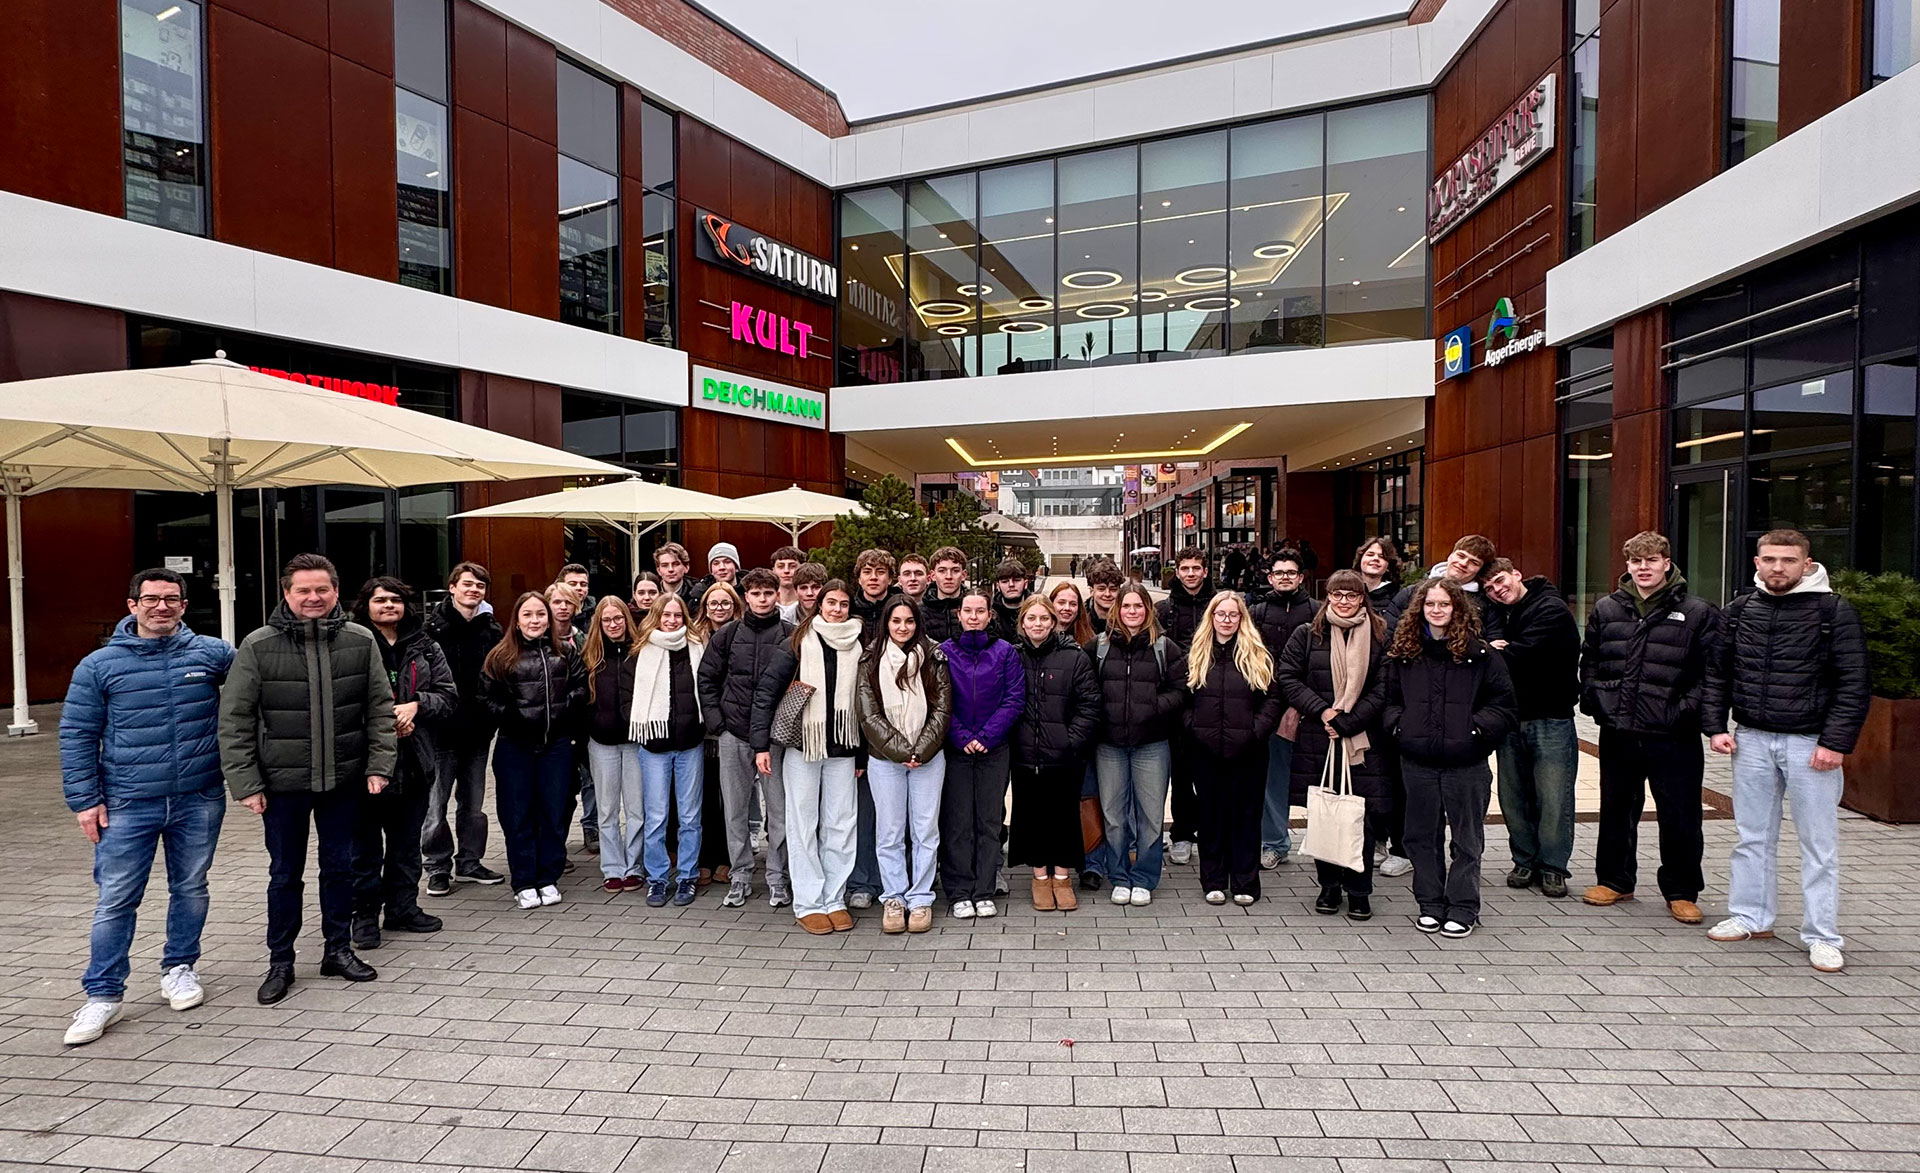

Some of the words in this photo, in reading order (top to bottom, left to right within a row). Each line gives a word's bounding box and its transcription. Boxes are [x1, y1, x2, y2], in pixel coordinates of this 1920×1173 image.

[1514, 134, 1537, 162] REWE
[753, 237, 837, 297] SATURN
[731, 301, 813, 358] KULT
[1484, 331, 1543, 366] AggerEnergie
[702, 378, 822, 420] DEICHMANN
